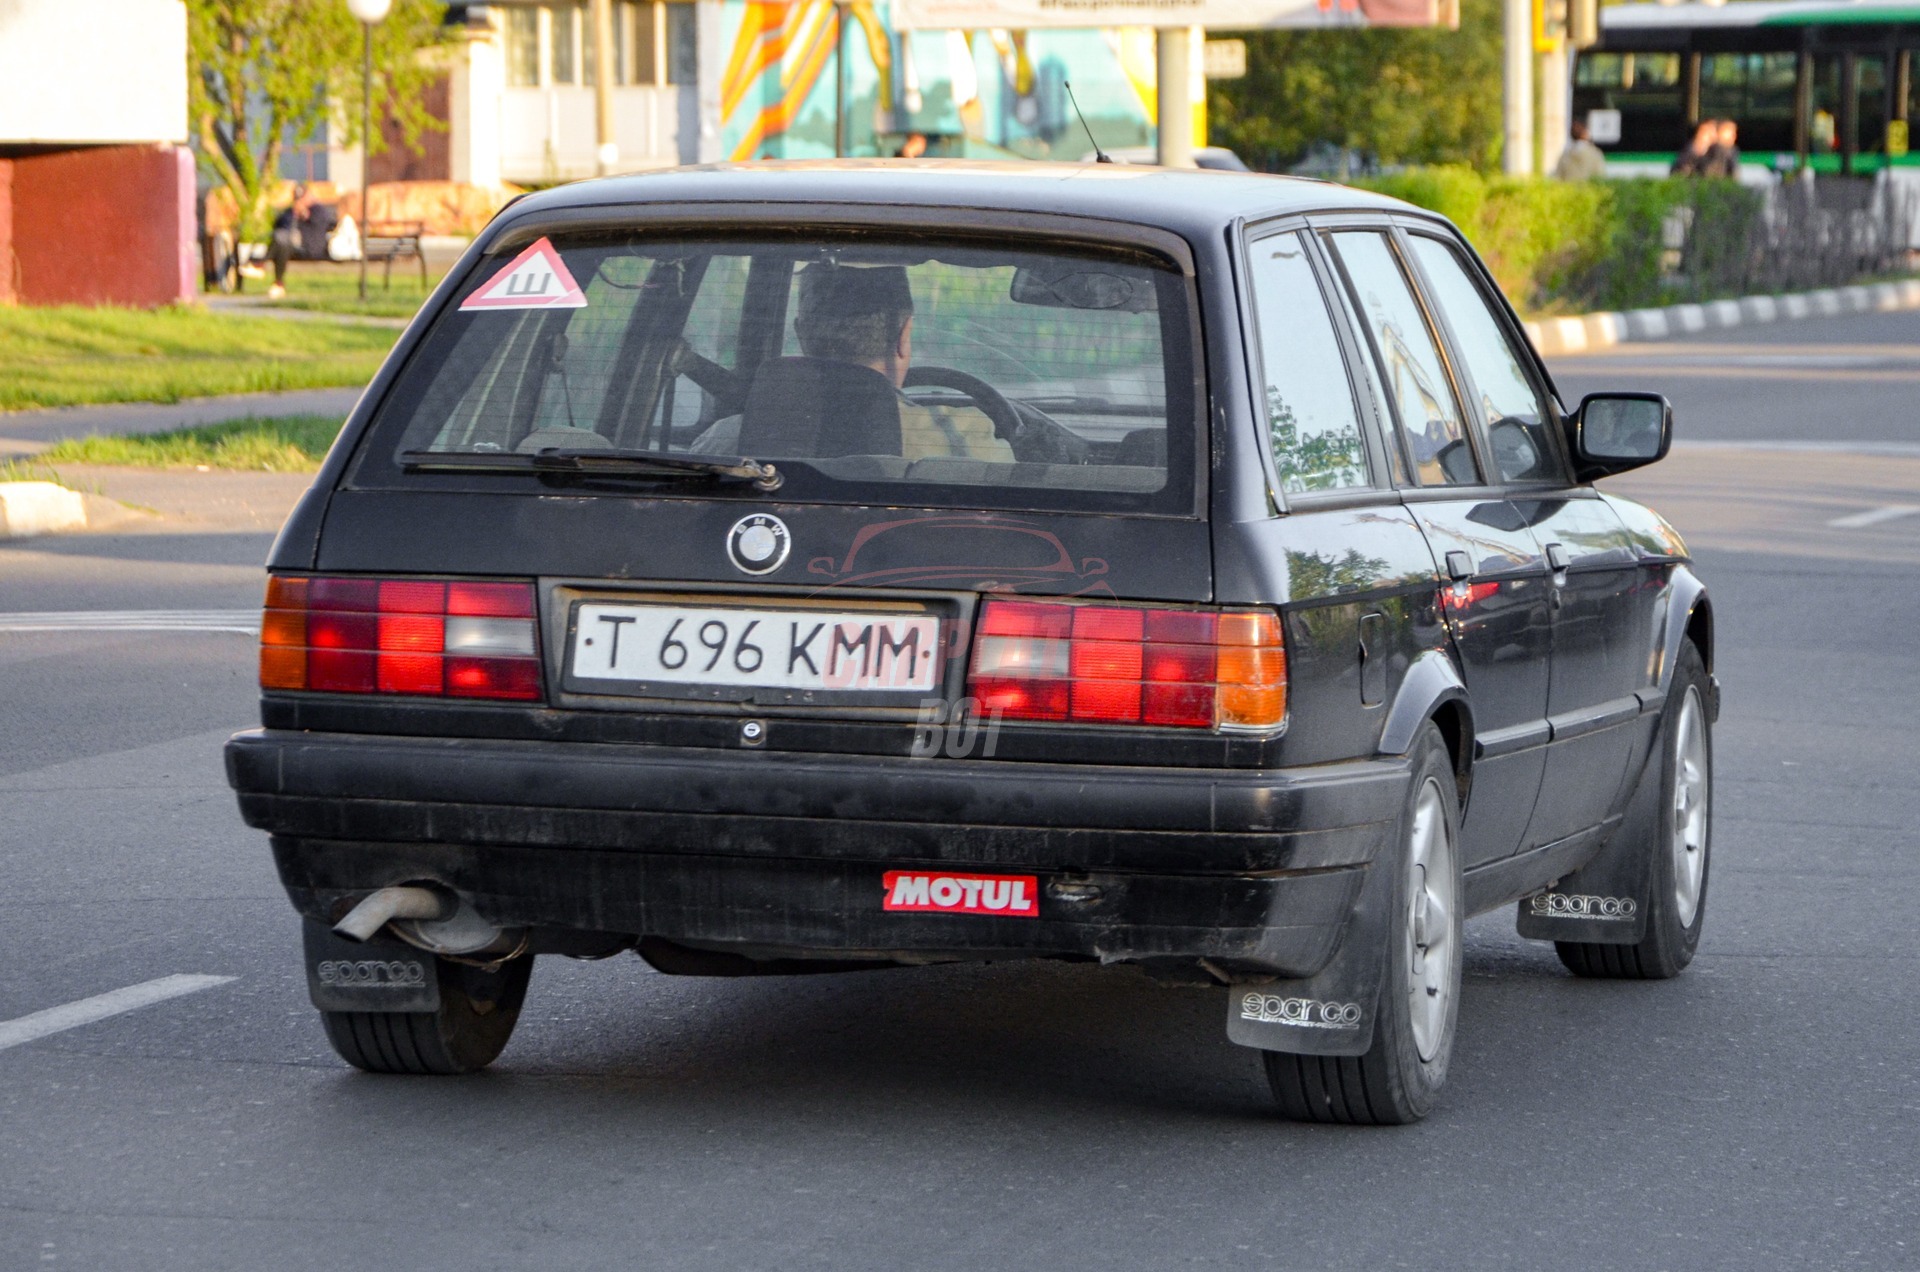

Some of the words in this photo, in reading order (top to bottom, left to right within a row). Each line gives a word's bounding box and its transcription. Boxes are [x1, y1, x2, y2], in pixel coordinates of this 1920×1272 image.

[506, 272, 552, 295] Ш
[660, 618, 764, 673] 696
[788, 621, 919, 679] KMM
[890, 876, 1031, 910] MOTUL
